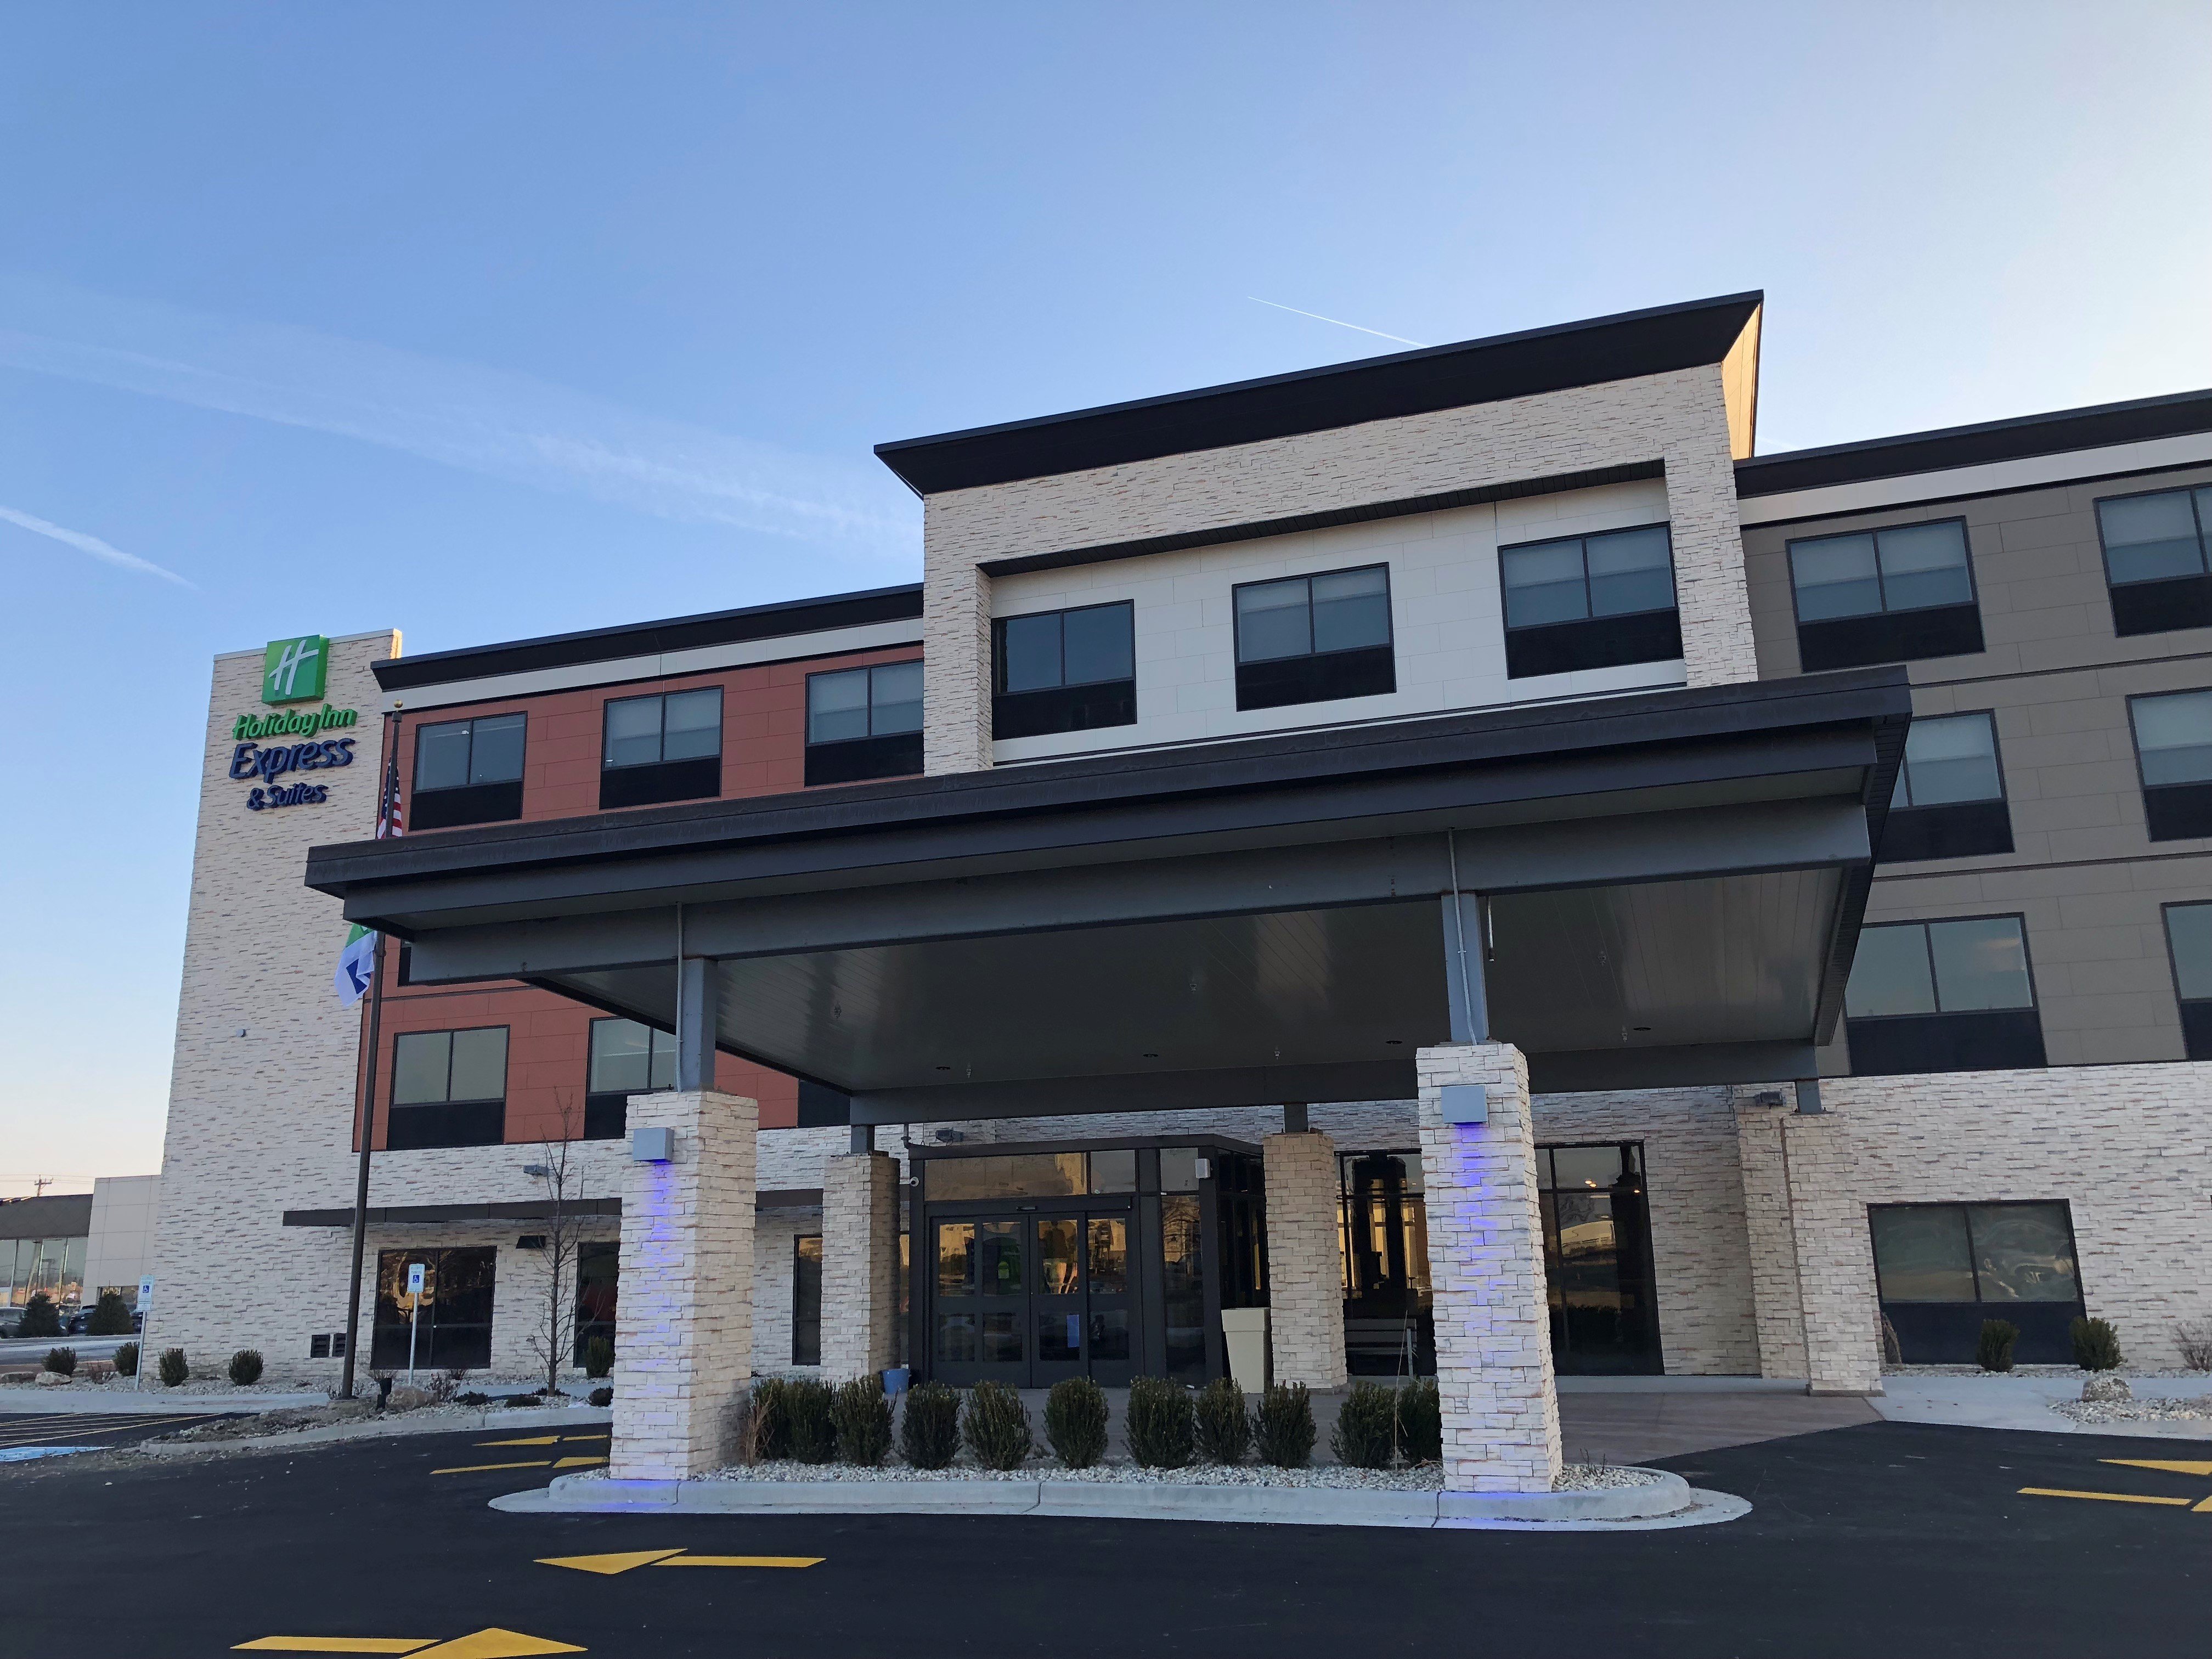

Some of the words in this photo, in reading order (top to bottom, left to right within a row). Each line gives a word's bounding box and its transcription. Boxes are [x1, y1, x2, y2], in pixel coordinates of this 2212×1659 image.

[269, 639, 319, 695] H
[232, 708, 320, 741] Holiday
[318, 703, 358, 730] Inn
[229, 738, 356, 785] Express
[247, 787, 264, 811] &
[264, 782, 329, 809] Suites
